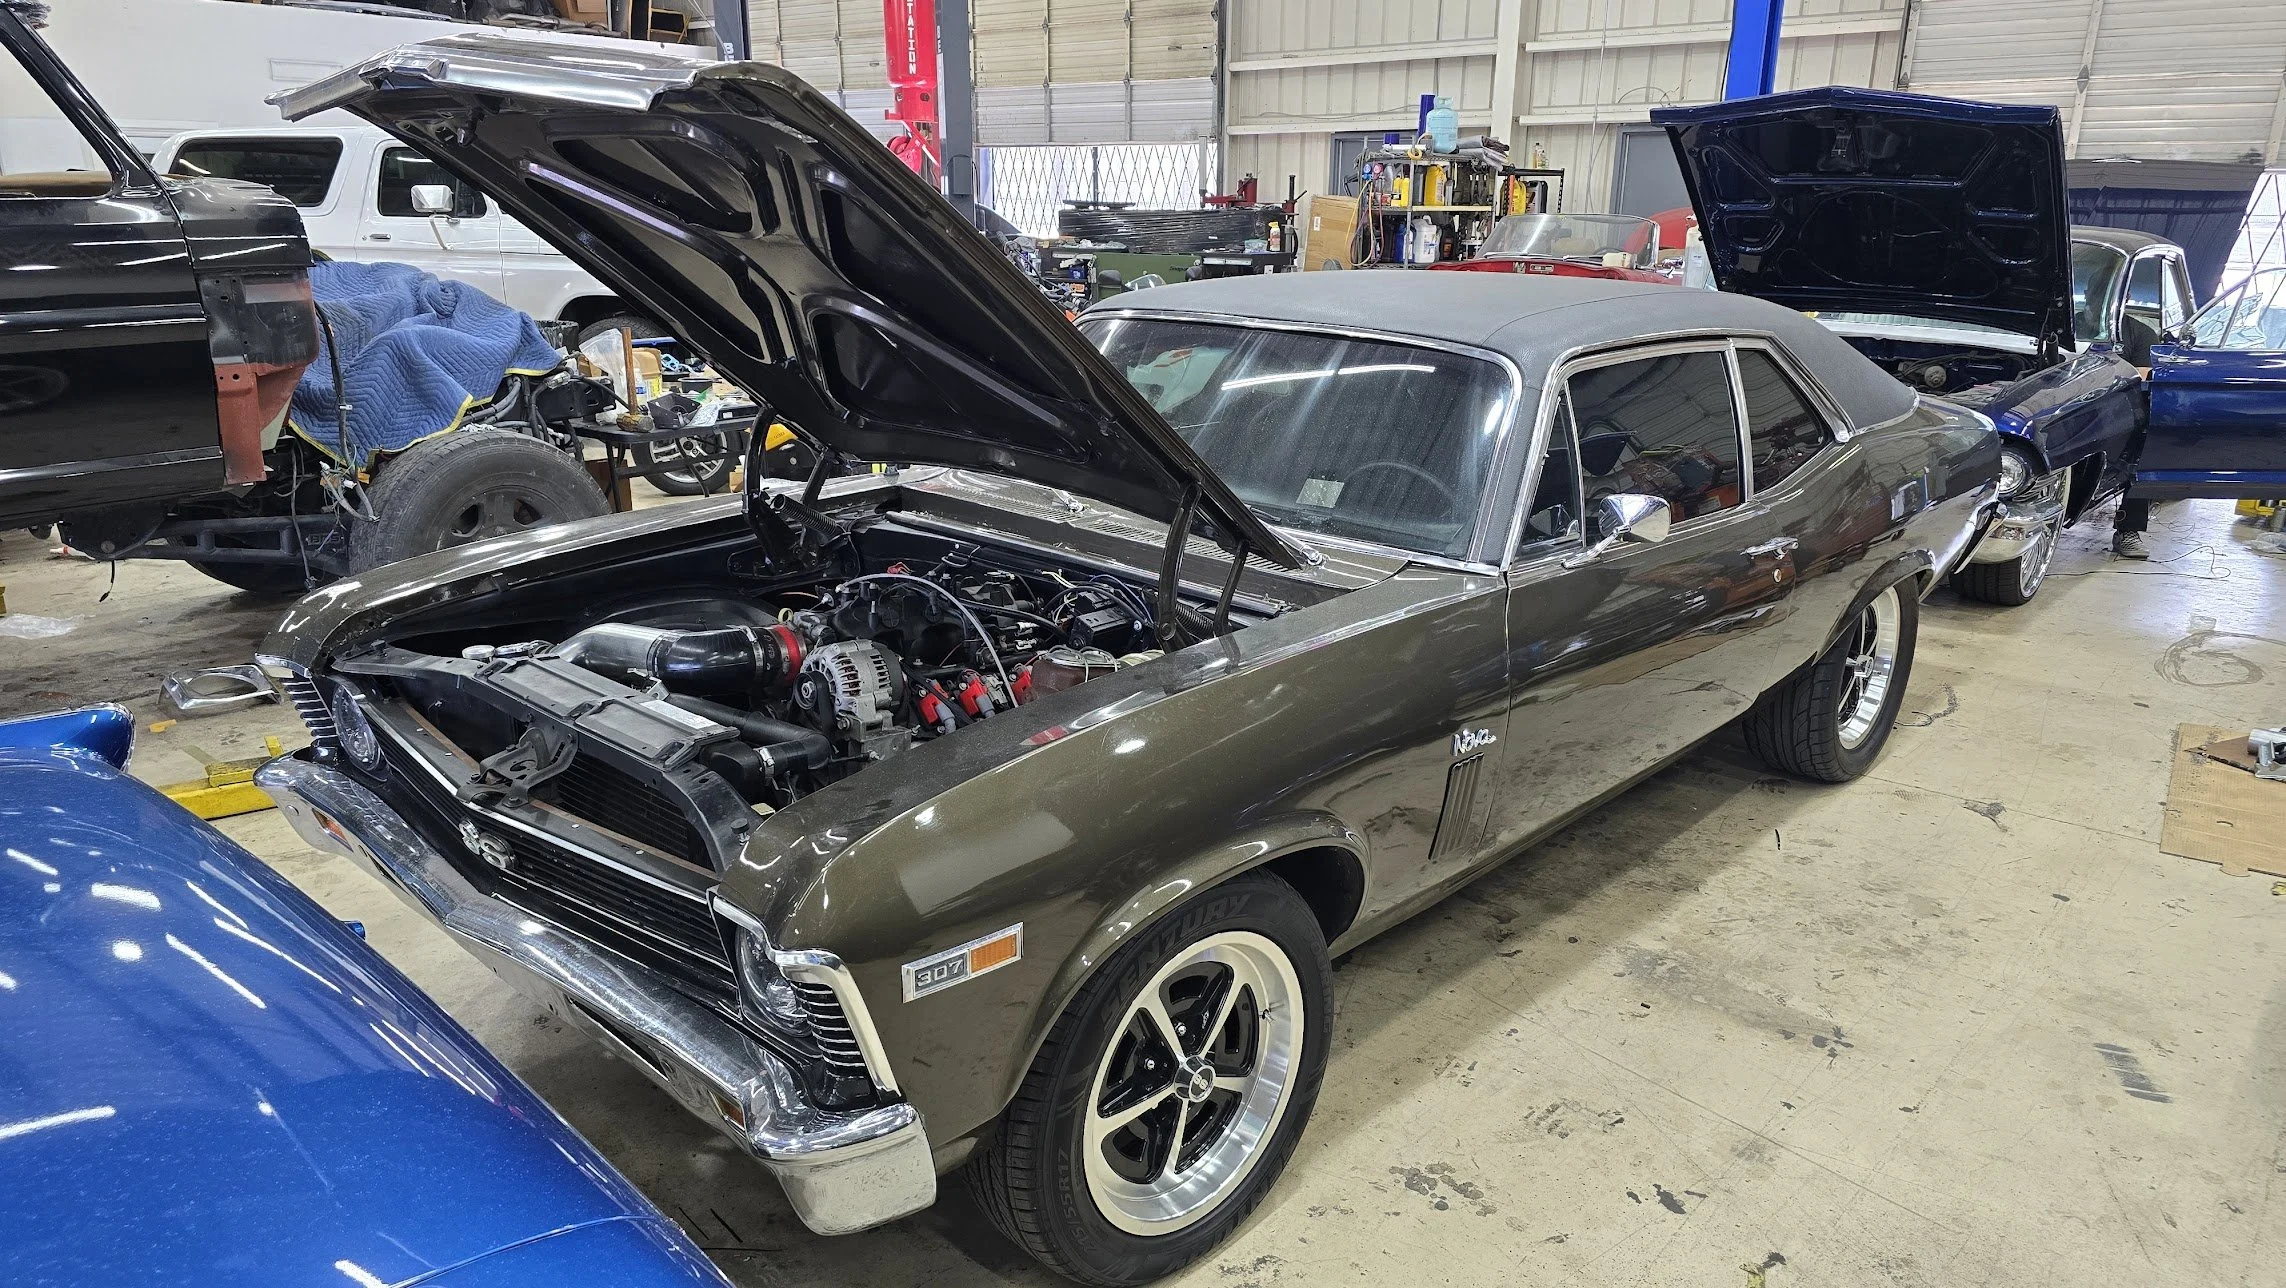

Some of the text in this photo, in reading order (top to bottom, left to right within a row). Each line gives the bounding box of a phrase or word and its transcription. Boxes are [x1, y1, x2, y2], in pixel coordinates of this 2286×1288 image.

[906, 0, 917, 75] TATION
[1452, 728, 1497, 757] Nova
[917, 958, 964, 987] 307
[1193, 1073, 1209, 1091] SS
